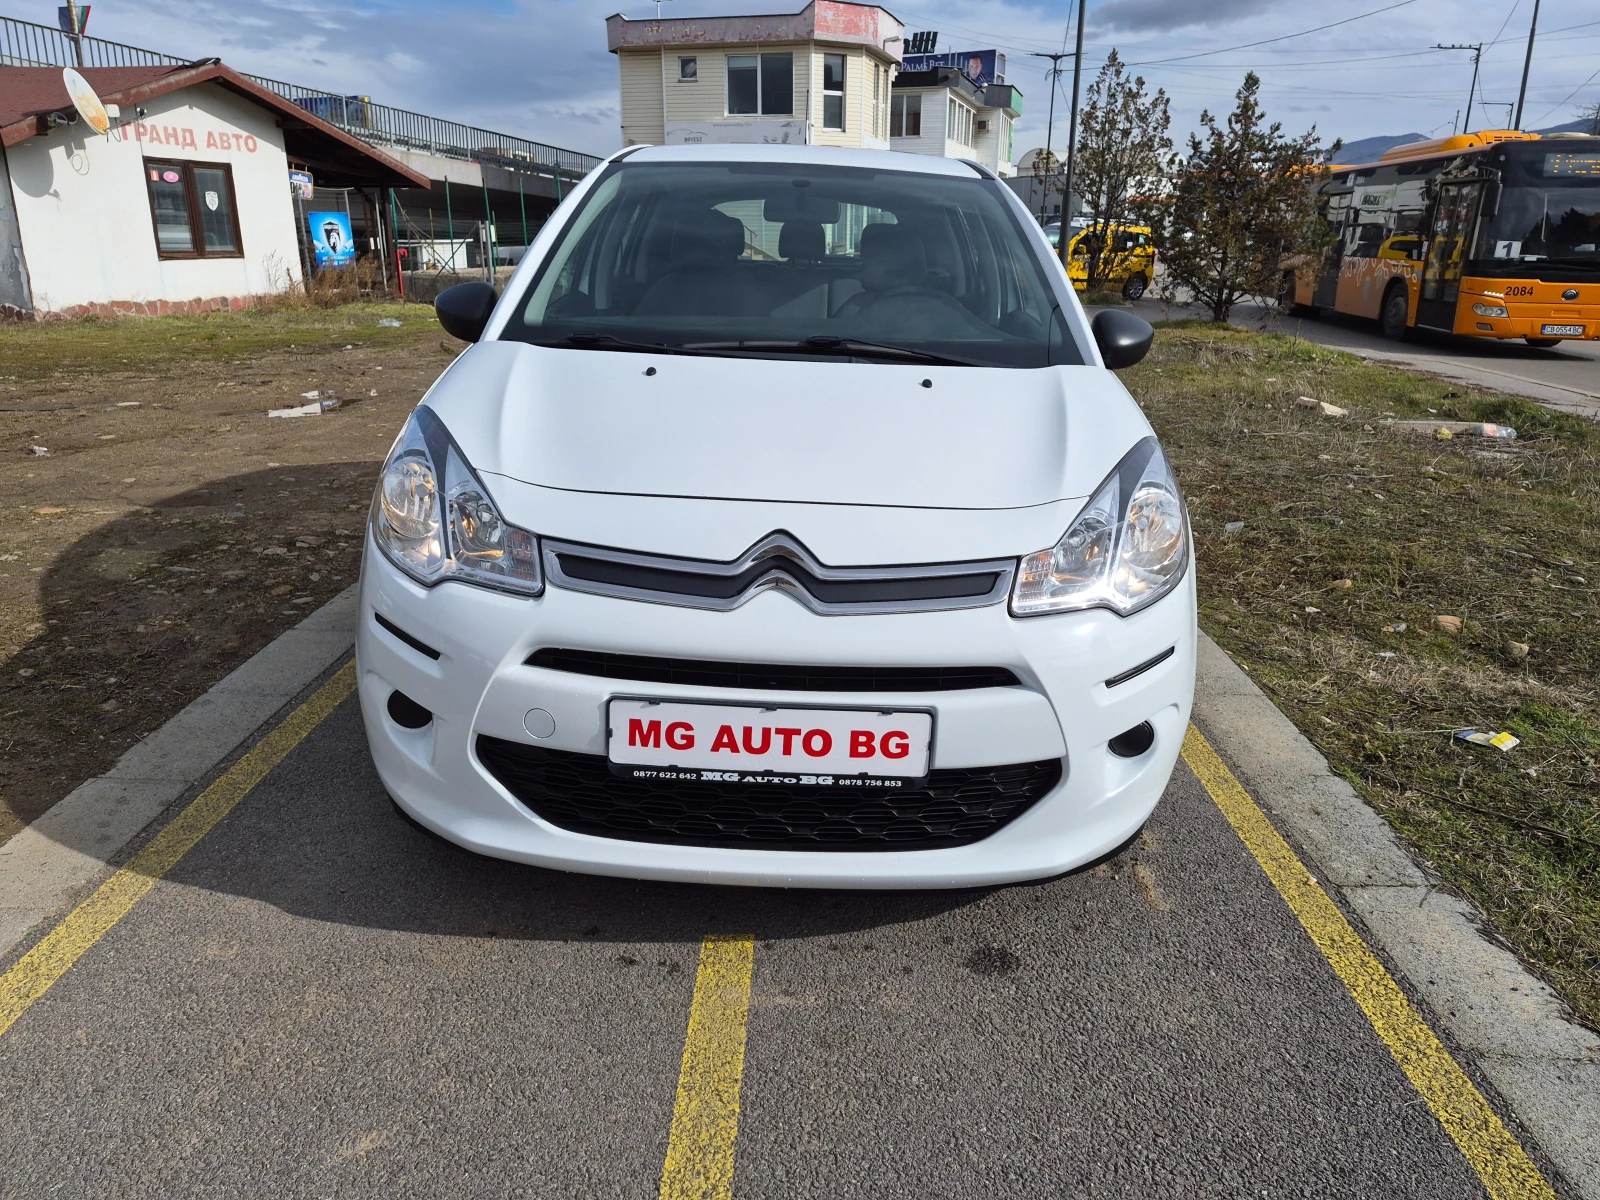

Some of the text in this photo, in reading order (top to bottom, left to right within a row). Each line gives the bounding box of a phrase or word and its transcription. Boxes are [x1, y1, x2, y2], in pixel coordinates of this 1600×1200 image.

[121, 122, 258, 153] ГРАНД АВТО
[1502, 241, 1514, 258] 1
[1504, 286, 1534, 296] 2084
[628, 718, 909, 759] MG AUTO BG
[633, 770, 657, 778] 0877
[659, 771, 677, 779] 622
[679, 772, 697, 780] 642
[700, 771, 741, 782] MG
[742, 776, 797, 784] AUTO
[799, 775, 835, 785] BG
[864, 779, 882, 787] 756
